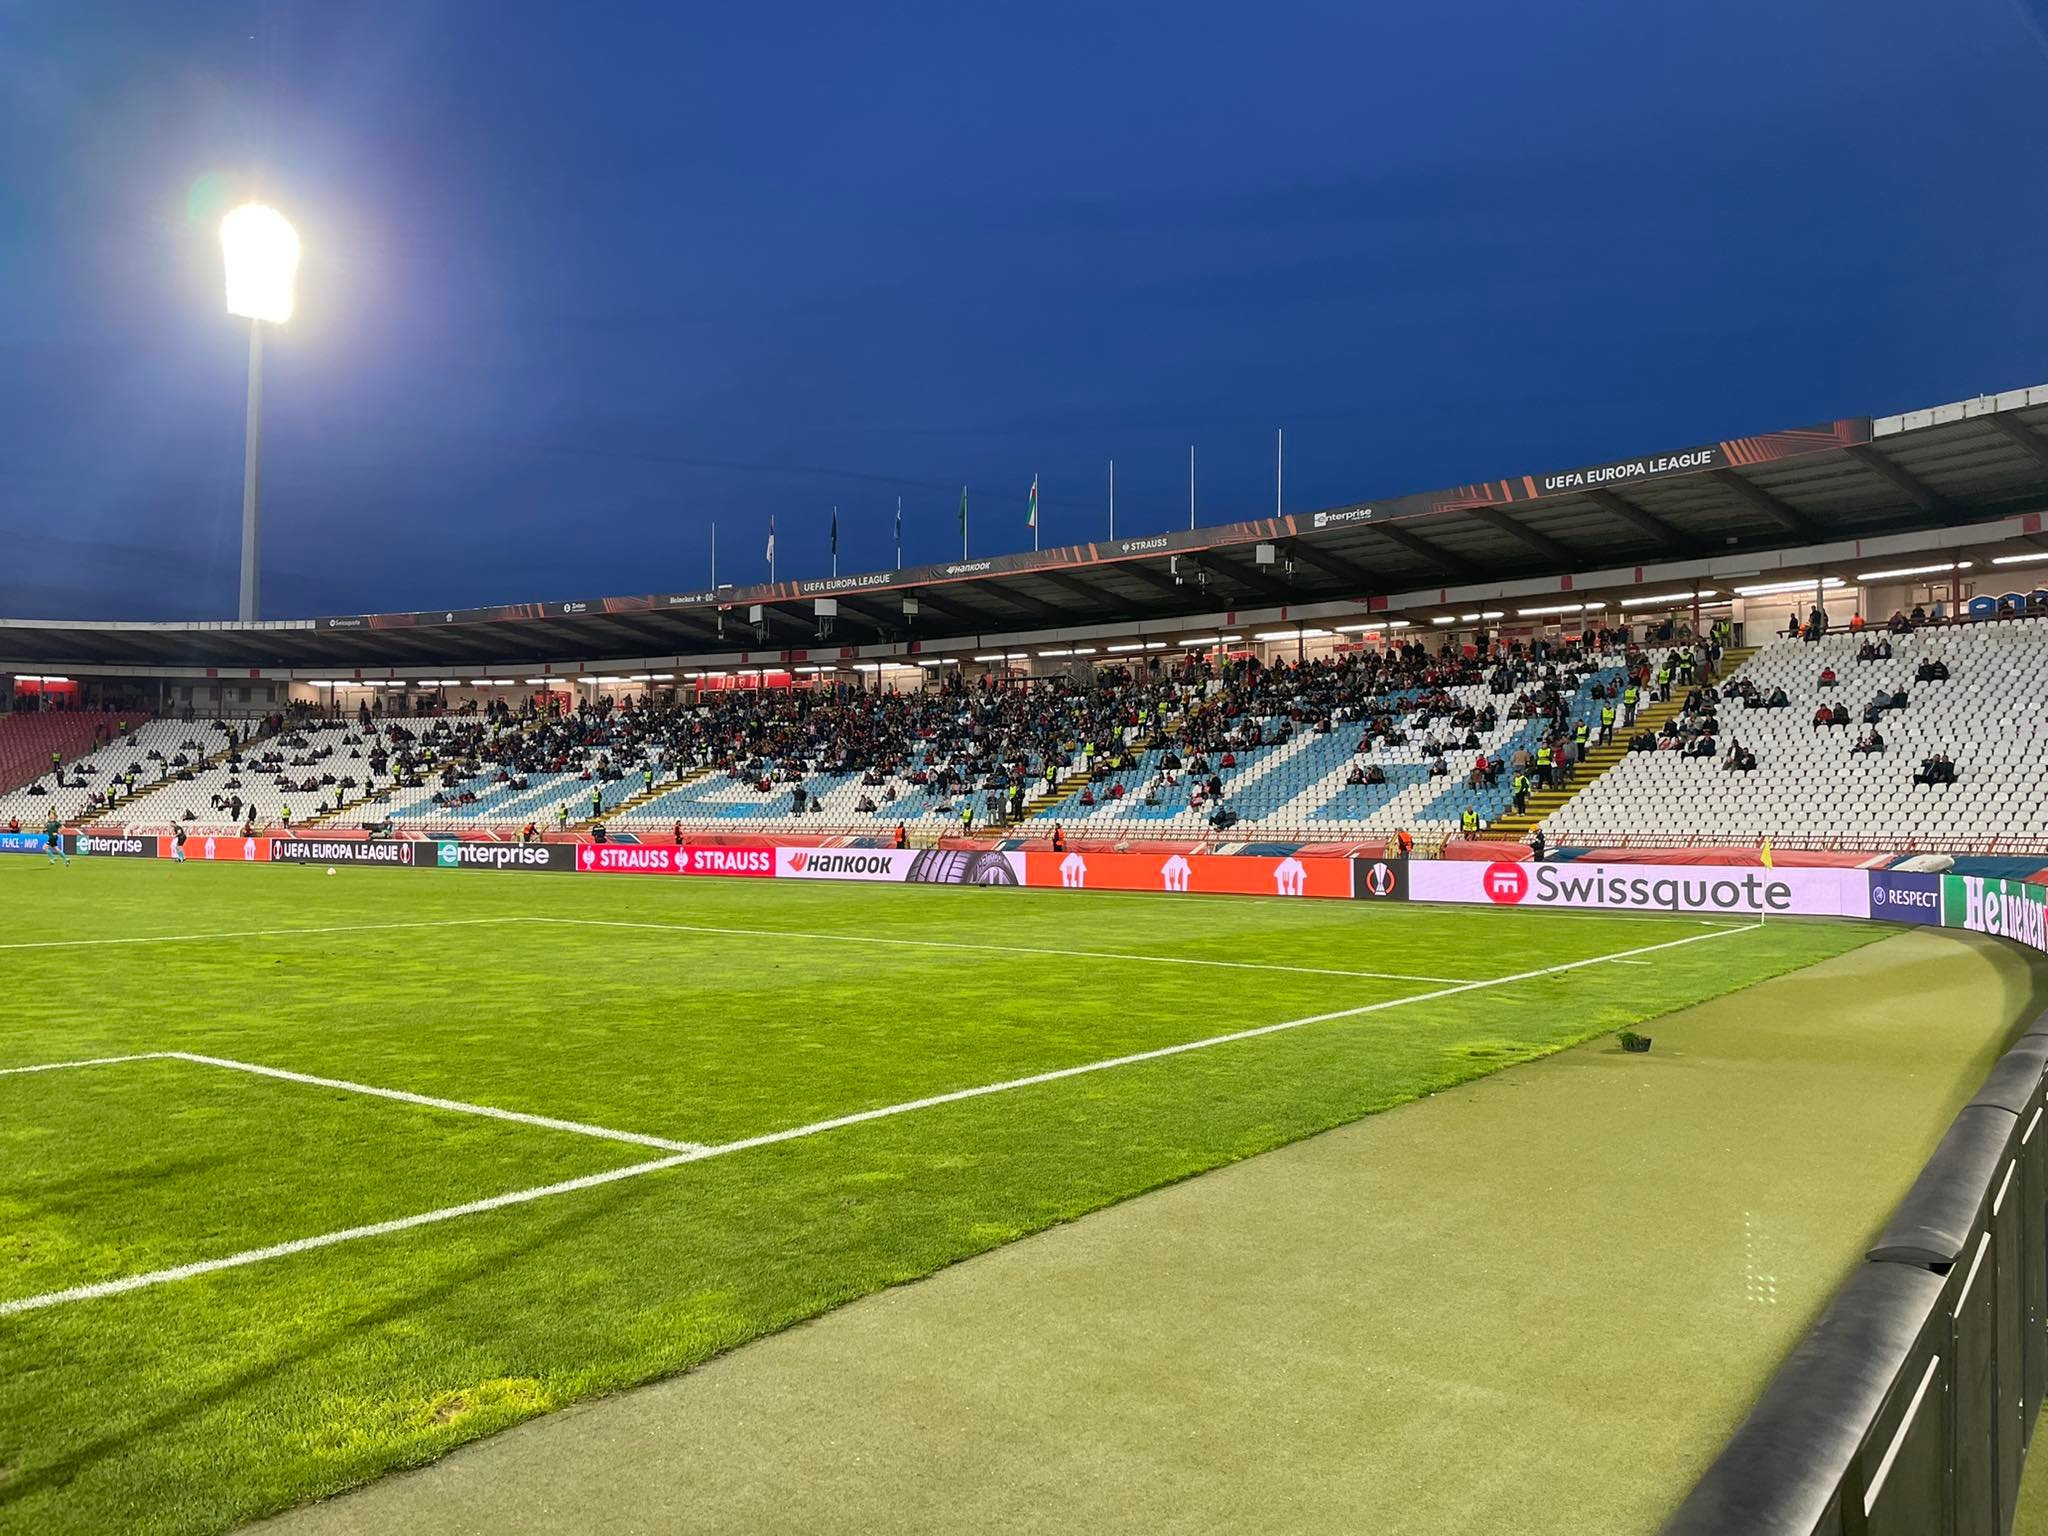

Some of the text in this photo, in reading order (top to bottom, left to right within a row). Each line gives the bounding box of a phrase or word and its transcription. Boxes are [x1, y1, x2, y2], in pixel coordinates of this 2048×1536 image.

[1545, 450, 1712, 490] UEFA EUROPA LEAGUE
[1131, 538, 1168, 551] STRAUSS
[803, 573, 891, 592] UEFA EUROPA LEAGUE
[2, 837, 19, 849] PEACE
[79, 837, 143, 855] enterprise
[284, 844, 398, 861] UEFA EUROPA LEAGUE
[442, 843, 550, 869] enterprise
[600, 849, 669, 868] STRAUSS
[694, 851, 770, 871] STRAUSS
[1536, 865, 1792, 910] Swissquote
[1888, 889, 1938, 908] RESPECT
[1963, 876, 2046, 952] Heineken
